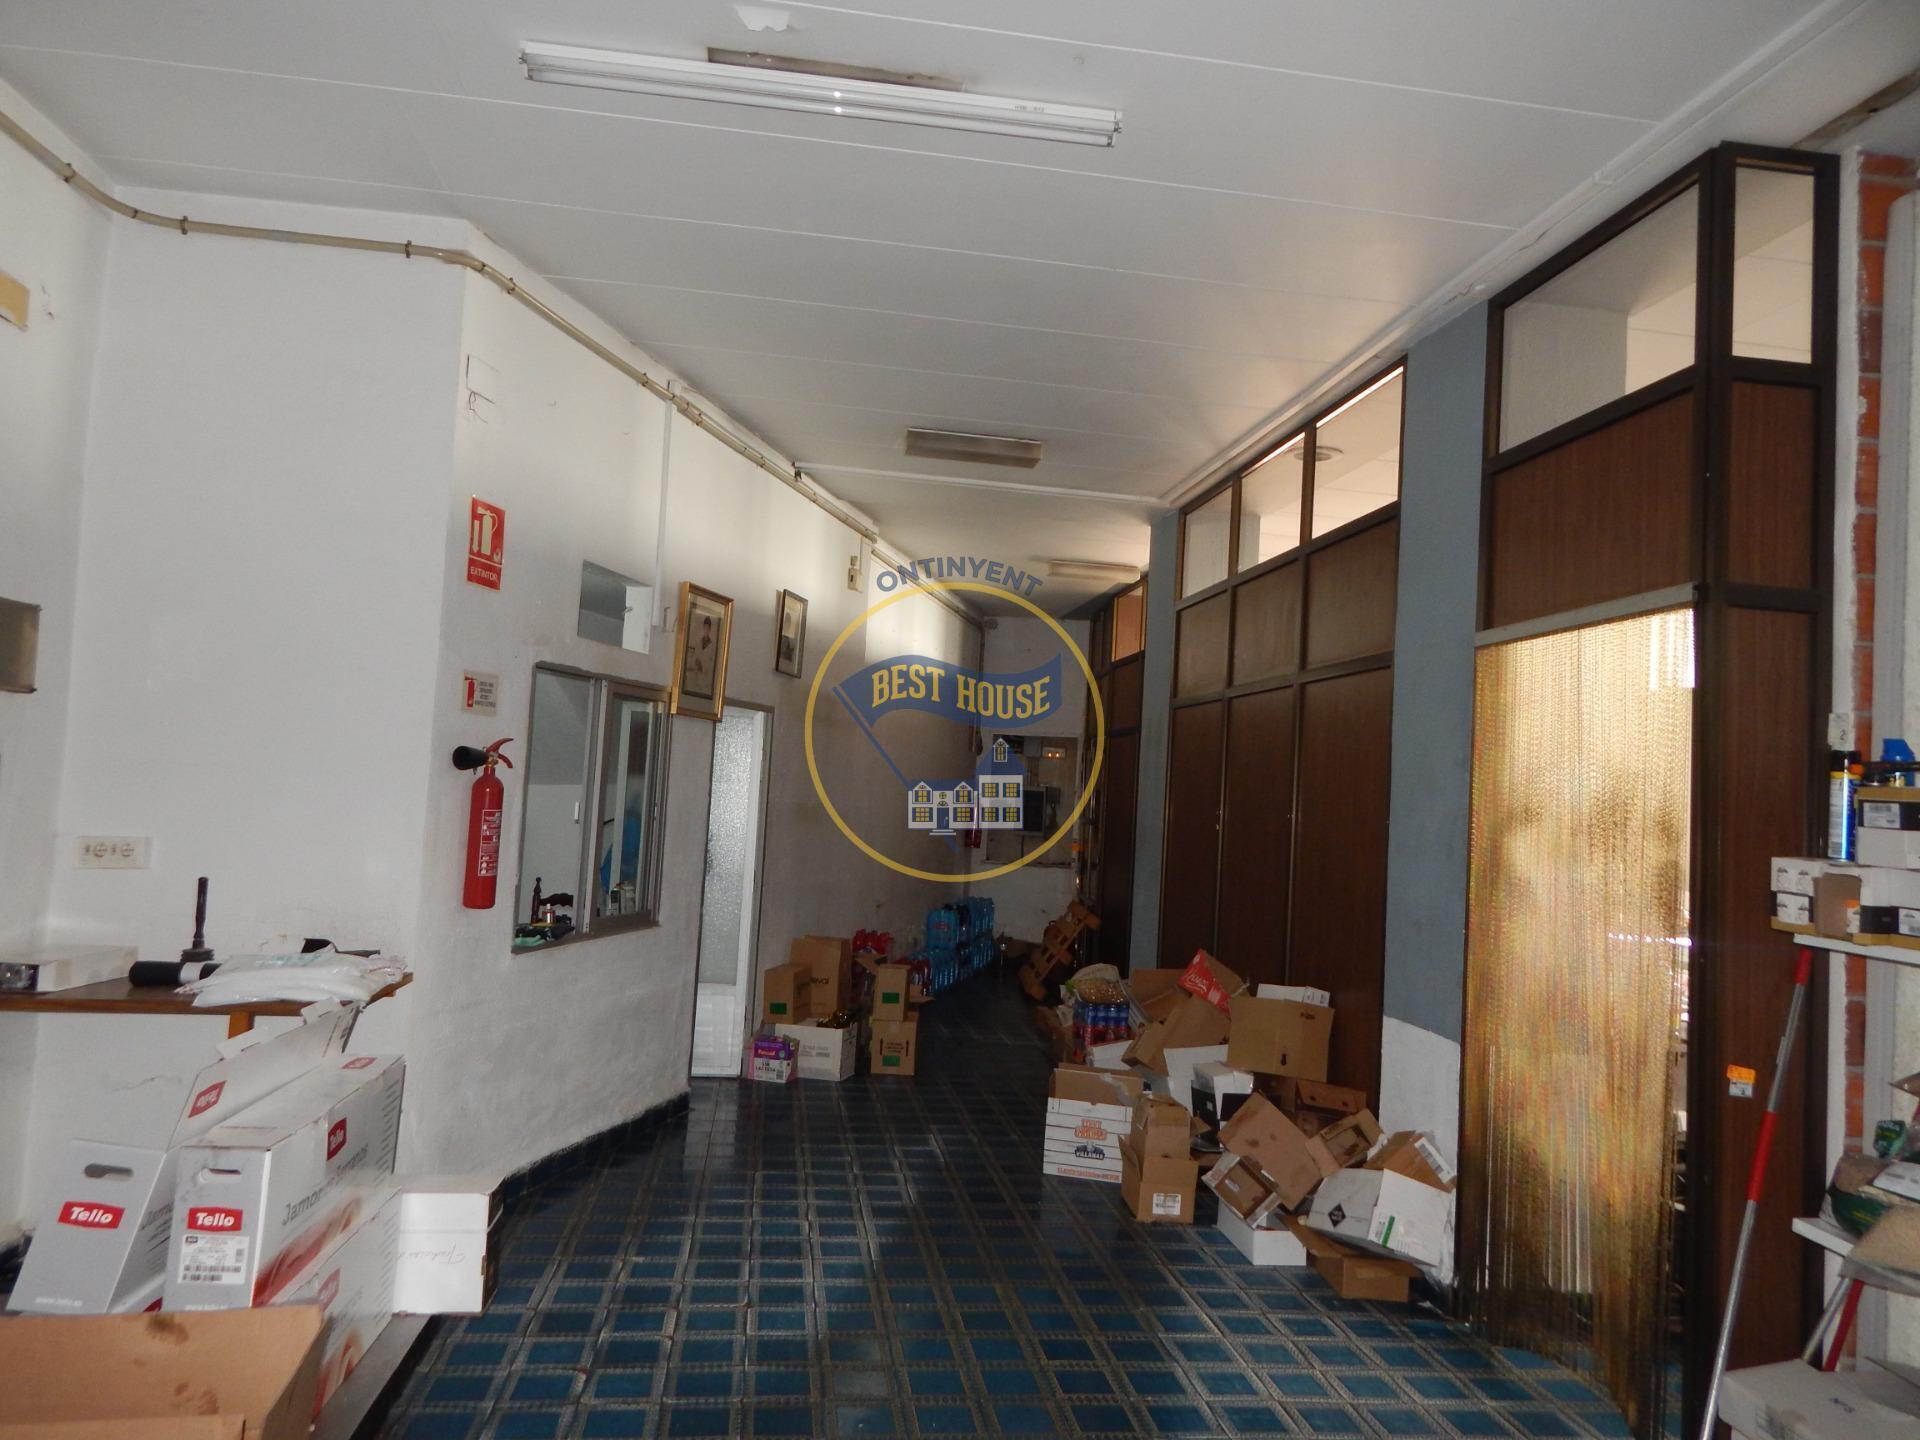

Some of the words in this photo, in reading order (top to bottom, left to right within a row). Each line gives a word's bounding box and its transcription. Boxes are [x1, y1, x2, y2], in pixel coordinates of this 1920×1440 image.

[470, 566, 499, 583] EXTINTOR
[70, 1206, 114, 1224] Tello
[196, 1212, 235, 1227] Tello
